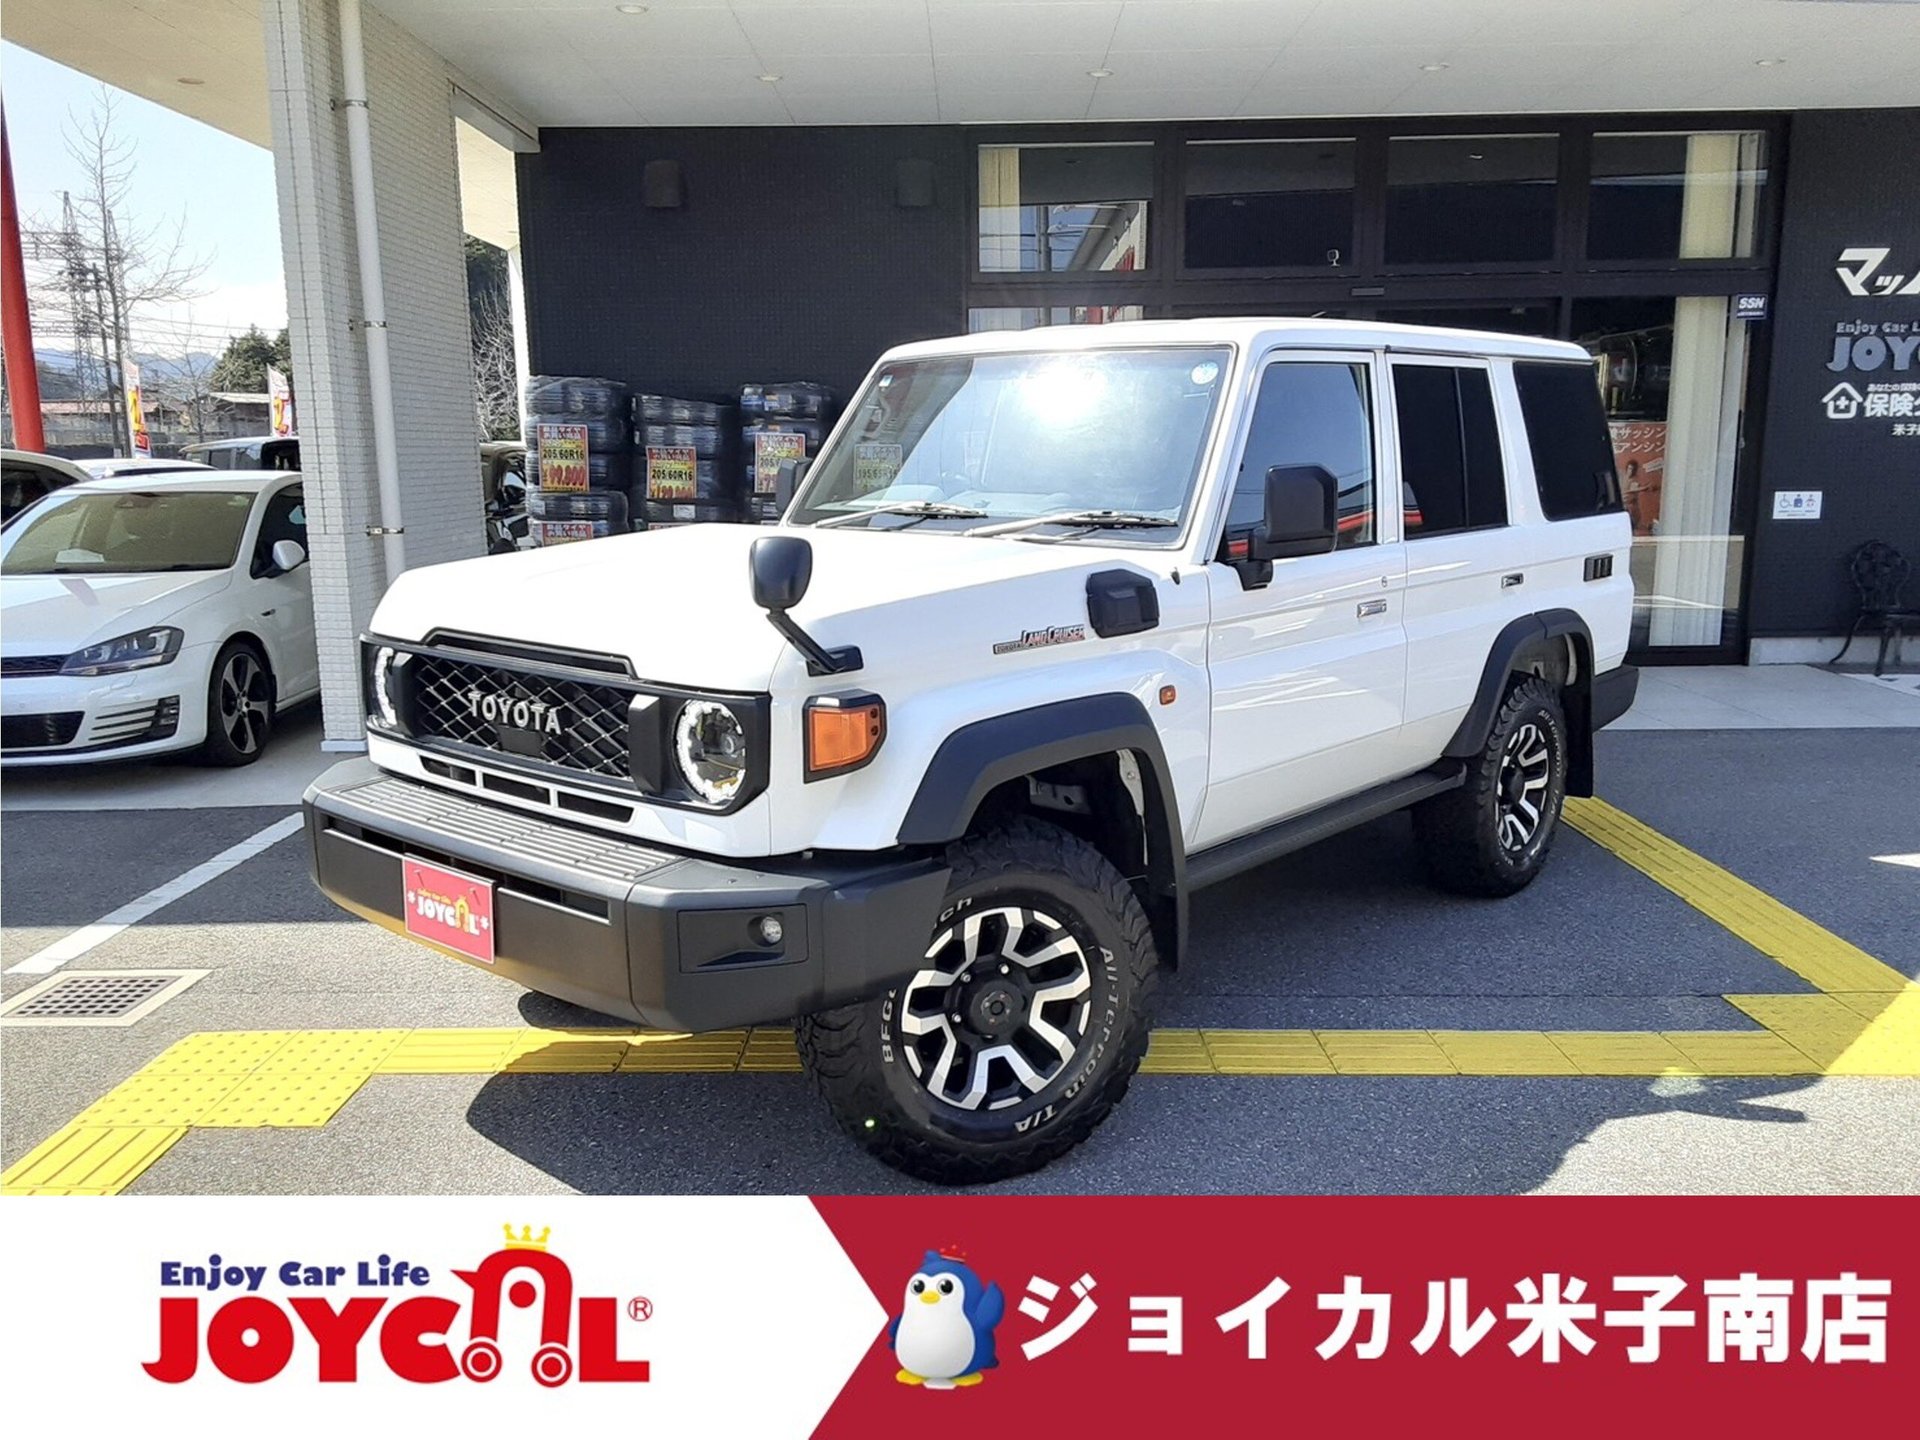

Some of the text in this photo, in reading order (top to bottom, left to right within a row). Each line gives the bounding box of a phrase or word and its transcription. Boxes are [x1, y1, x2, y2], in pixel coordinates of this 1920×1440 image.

[1836, 320, 1878, 335] Enjoy
[1882, 322, 1909, 333] Car
[1825, 336, 1920, 371] JOY
[1891, 423, 1920, 436] 米子
[467, 690, 561, 735] TOYOTA
[1014, 1105, 1058, 1133] T/A
